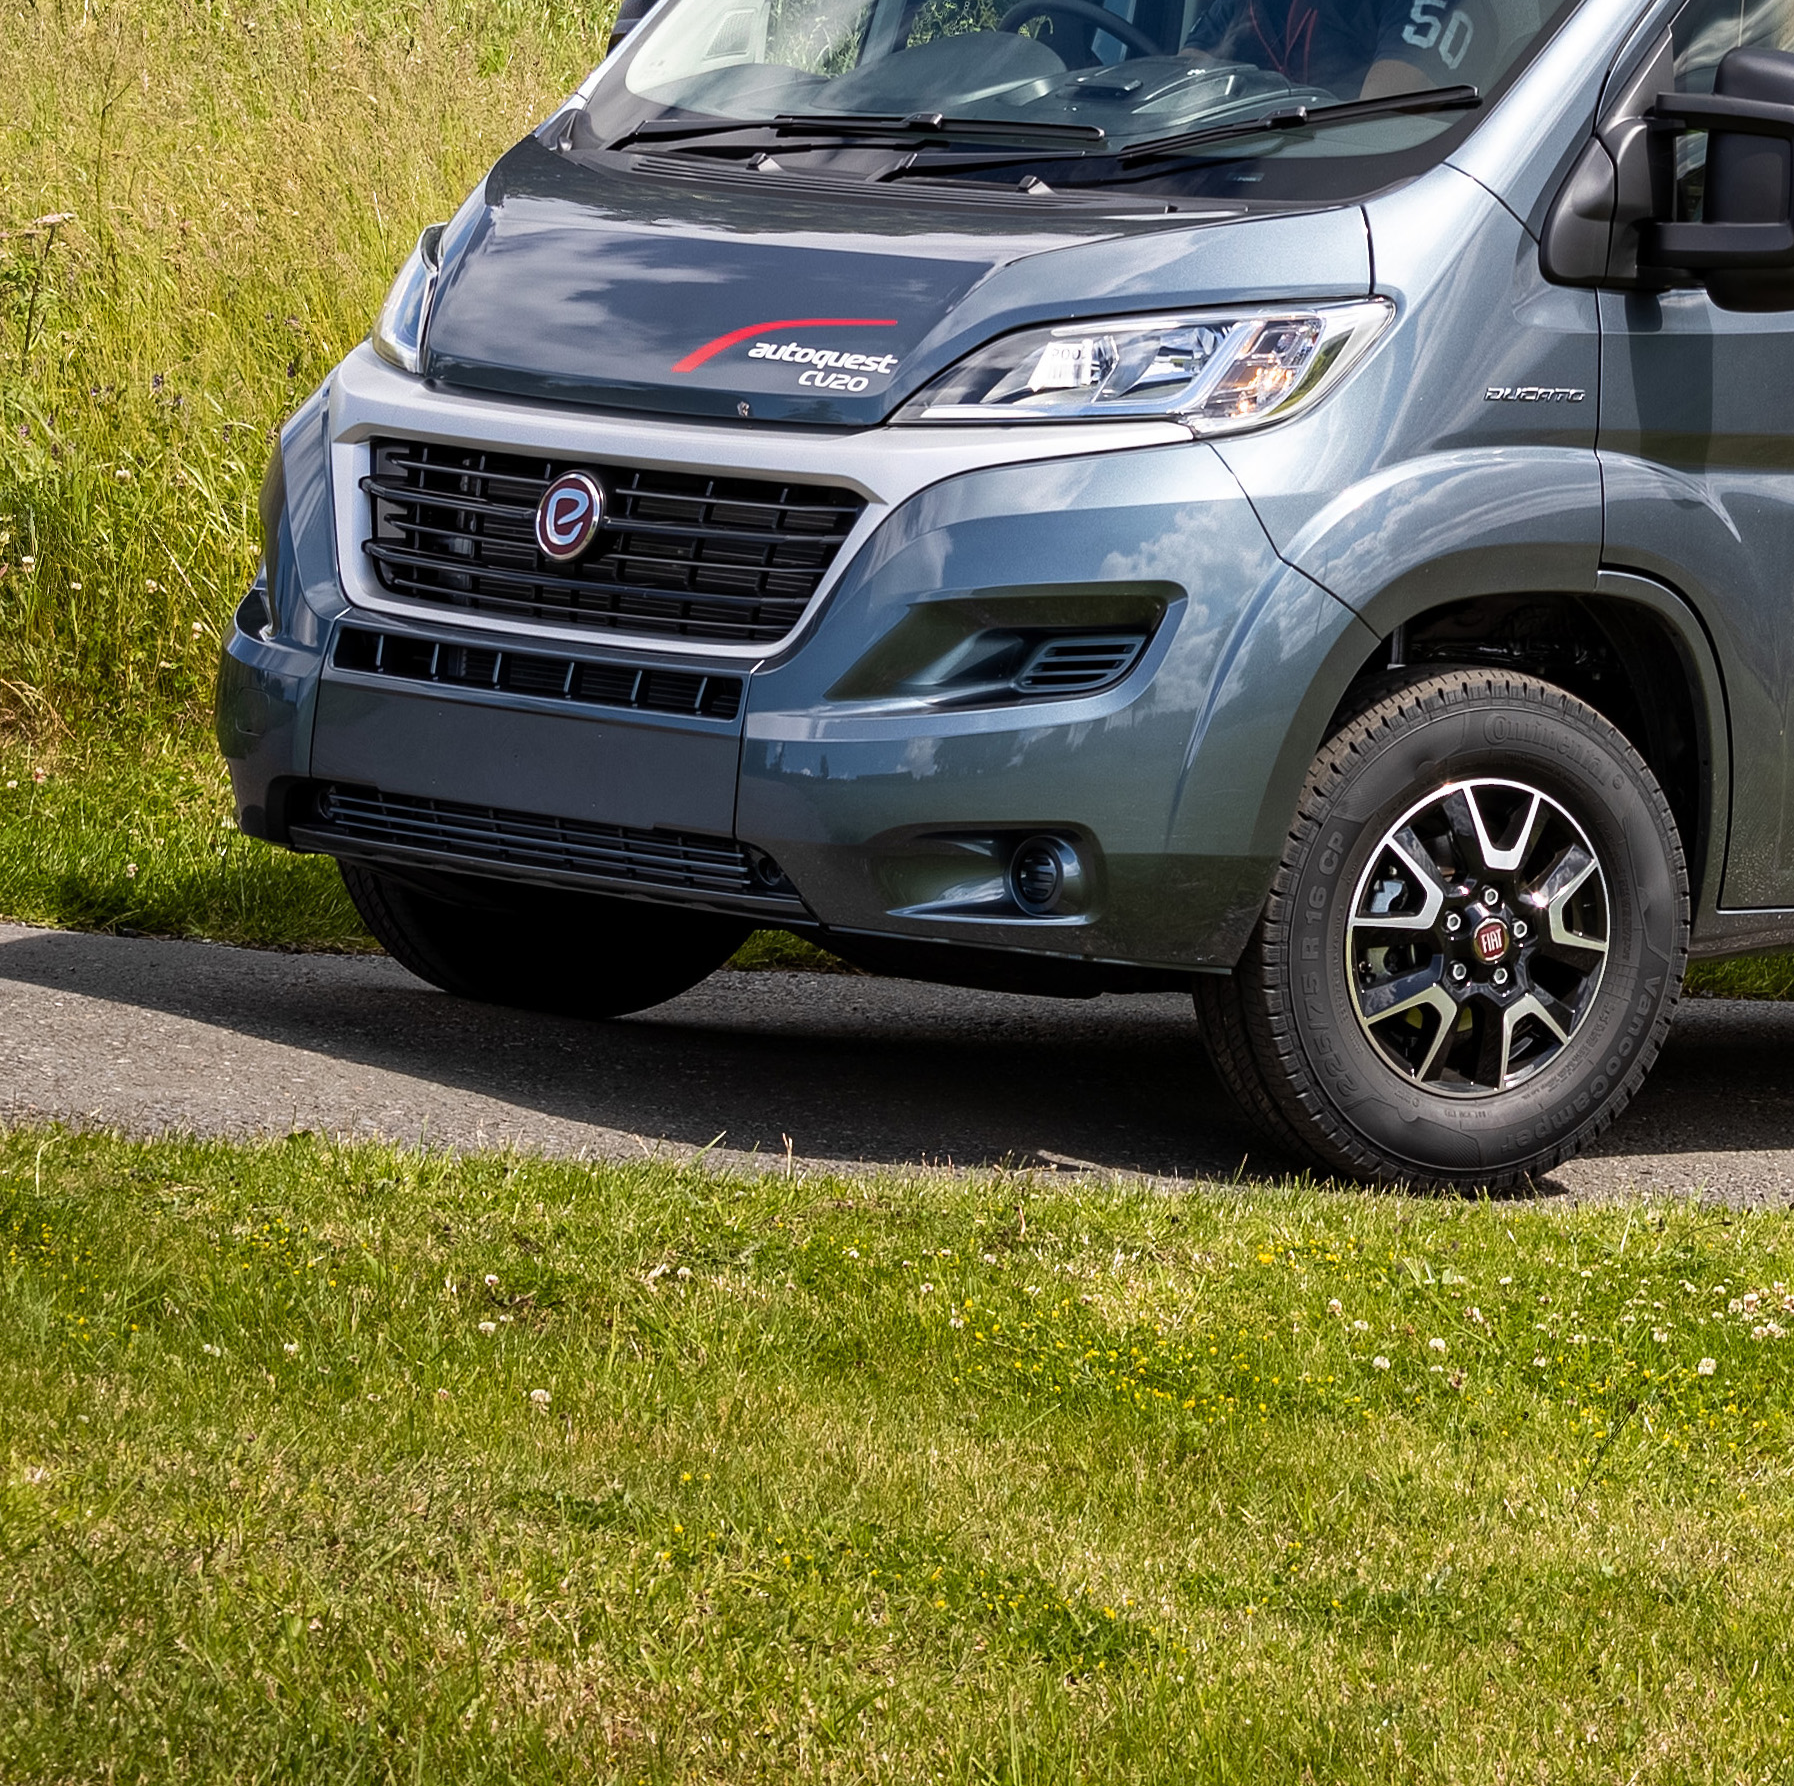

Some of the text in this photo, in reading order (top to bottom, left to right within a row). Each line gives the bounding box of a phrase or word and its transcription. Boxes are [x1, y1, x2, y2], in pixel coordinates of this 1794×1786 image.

[748, 342, 898, 374] autoquest
[798, 370, 869, 392] CV20
[1484, 386, 1585, 401] DUCATO
[1319, 830, 1344, 876] CP
[1305, 885, 1328, 926] 16
[1301, 936, 1320, 960] R
[1481, 927, 1503, 954] FIAT
